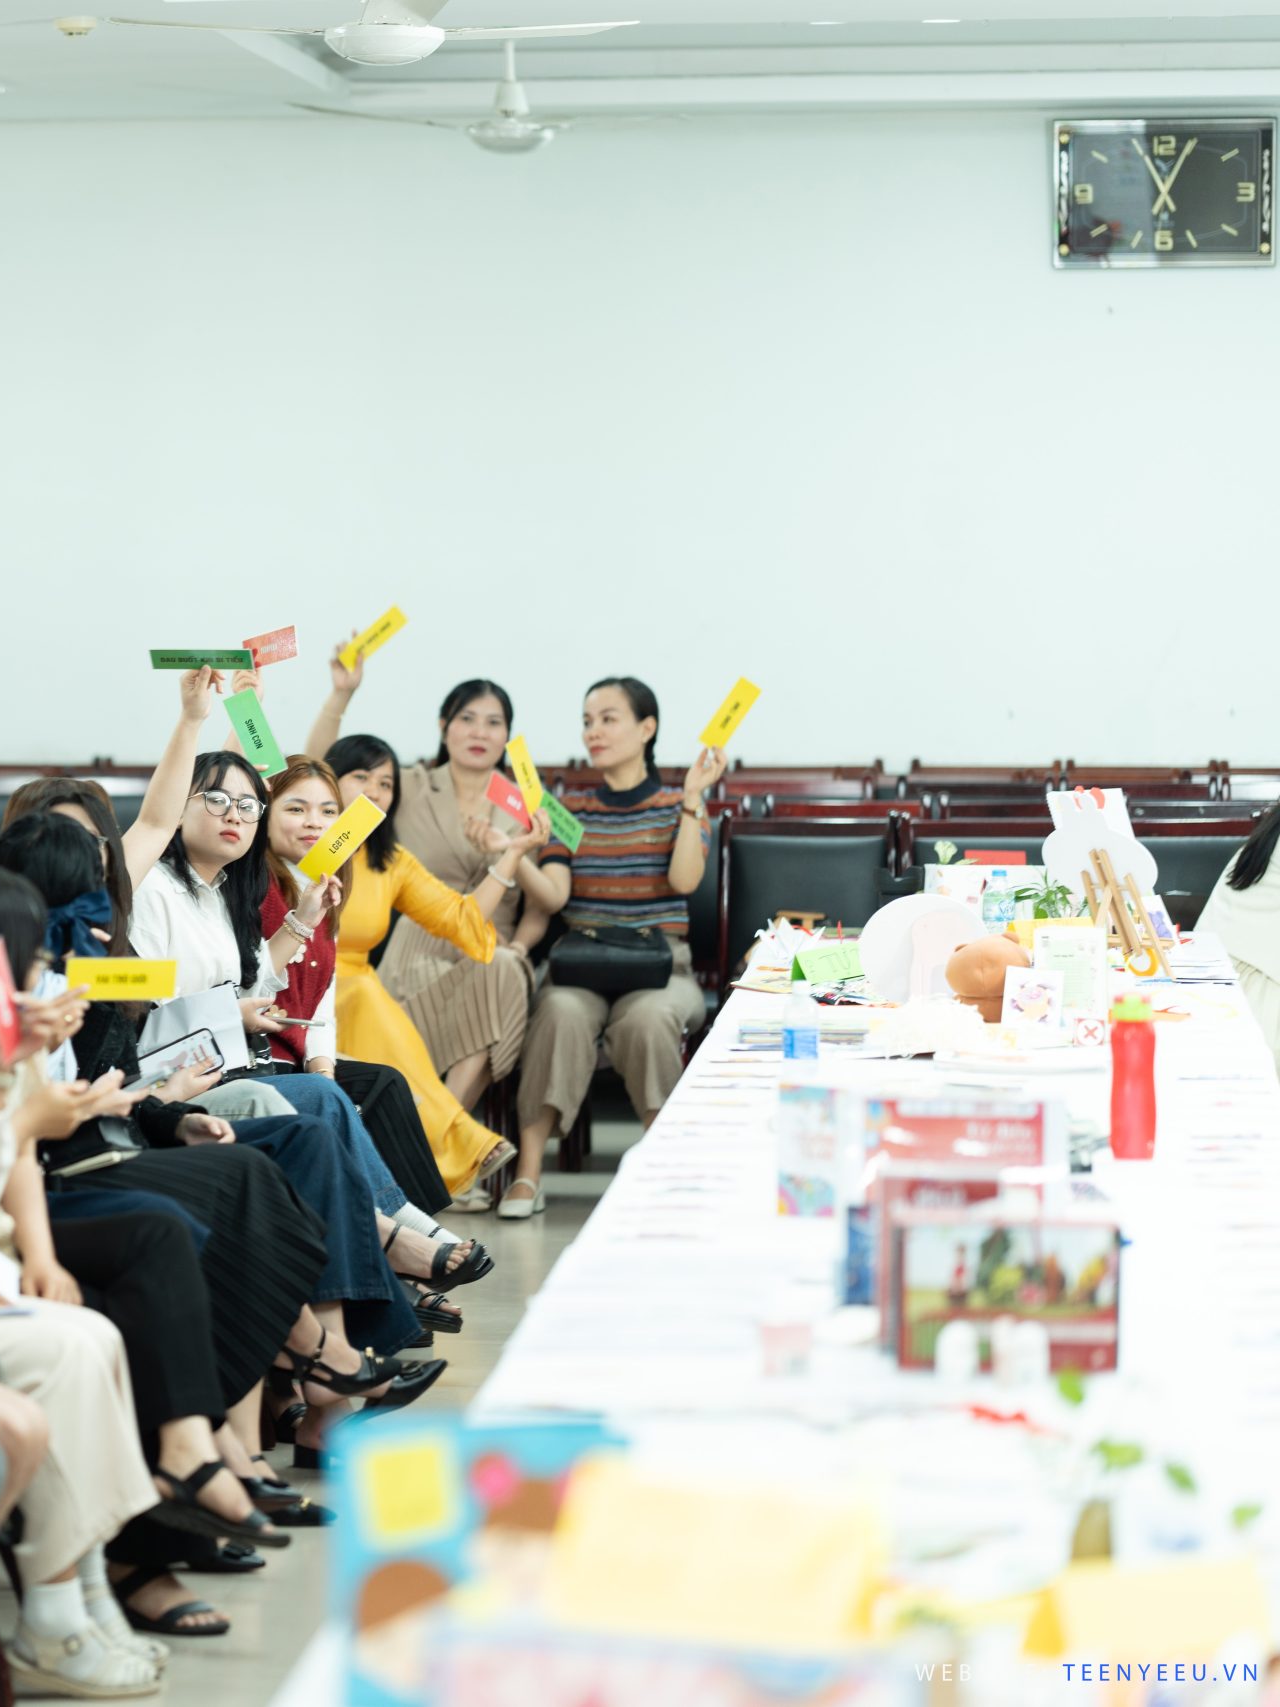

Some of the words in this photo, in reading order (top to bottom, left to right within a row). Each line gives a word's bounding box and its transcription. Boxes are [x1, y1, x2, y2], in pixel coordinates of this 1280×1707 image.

[1153, 135, 1176, 156] 12
[1074, 183, 1093, 205] 9
[1236, 181, 1256, 203] 3
[1154, 229, 1174, 252] 6
[244, 718, 256, 735] SINH
[251, 734, 264, 750] CON
